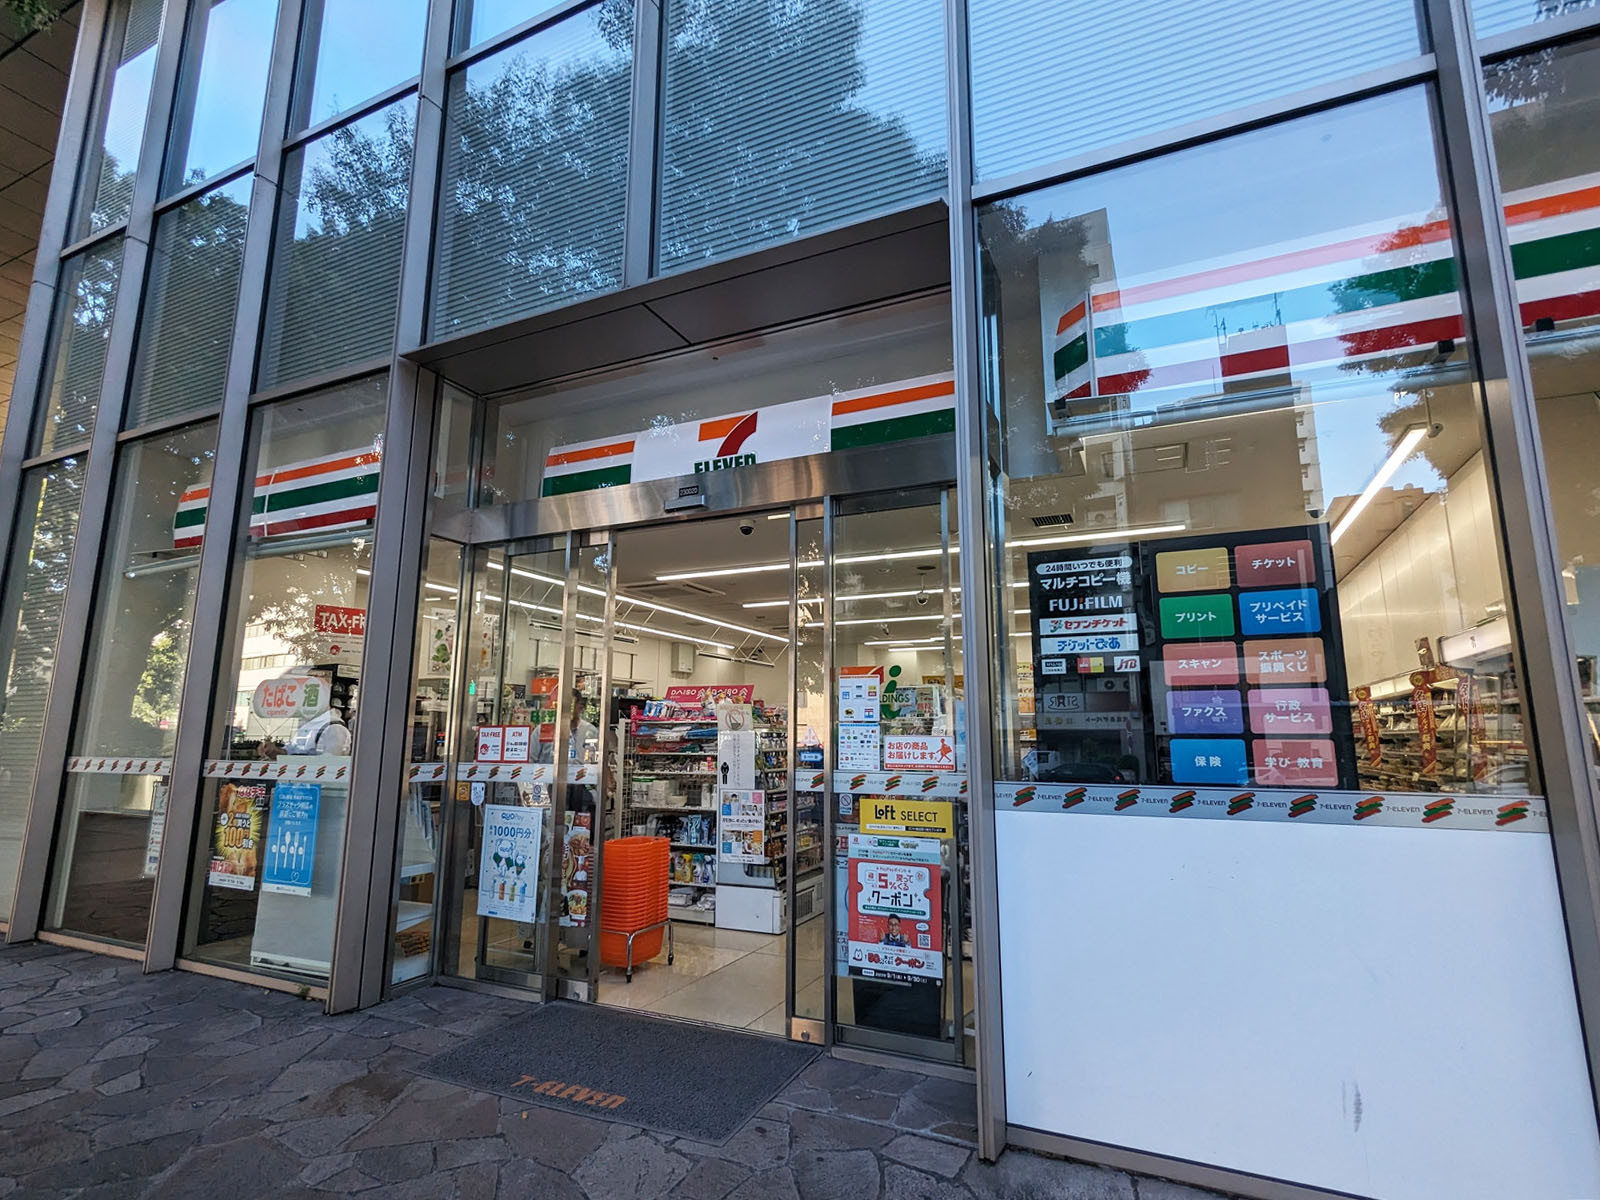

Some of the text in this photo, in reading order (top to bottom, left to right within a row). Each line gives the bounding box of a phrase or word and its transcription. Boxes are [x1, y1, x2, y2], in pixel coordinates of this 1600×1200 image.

[1046, 559, 1122, 572] 24時間いつでも便利
[1251, 557, 1296, 569] チケット
[1176, 564, 1208, 575] コピー
[1040, 571, 1131, 589] マルチコピー機
[1249, 600, 1308, 612] プリペイド
[1175, 611, 1217, 623] プリント
[1255, 612, 1304, 624] サービス
[1064, 617, 1127, 630] セブンチケット
[1057, 637, 1121, 651] チケットぴあ
[1258, 650, 1307, 661] スポーツ
[1178, 659, 1222, 669] スキャン
[261, 683, 320, 707] たばこ 酒
[1182, 706, 1226, 717] ファクス
[1275, 700, 1302, 711] 行政
[1264, 712, 1315, 723] サービス
[888, 741, 928, 750] お店の商品
[1194, 756, 1222, 767] 保険
[900, 810, 938, 822] SELECT
[871, 890, 913, 907] クーポン
